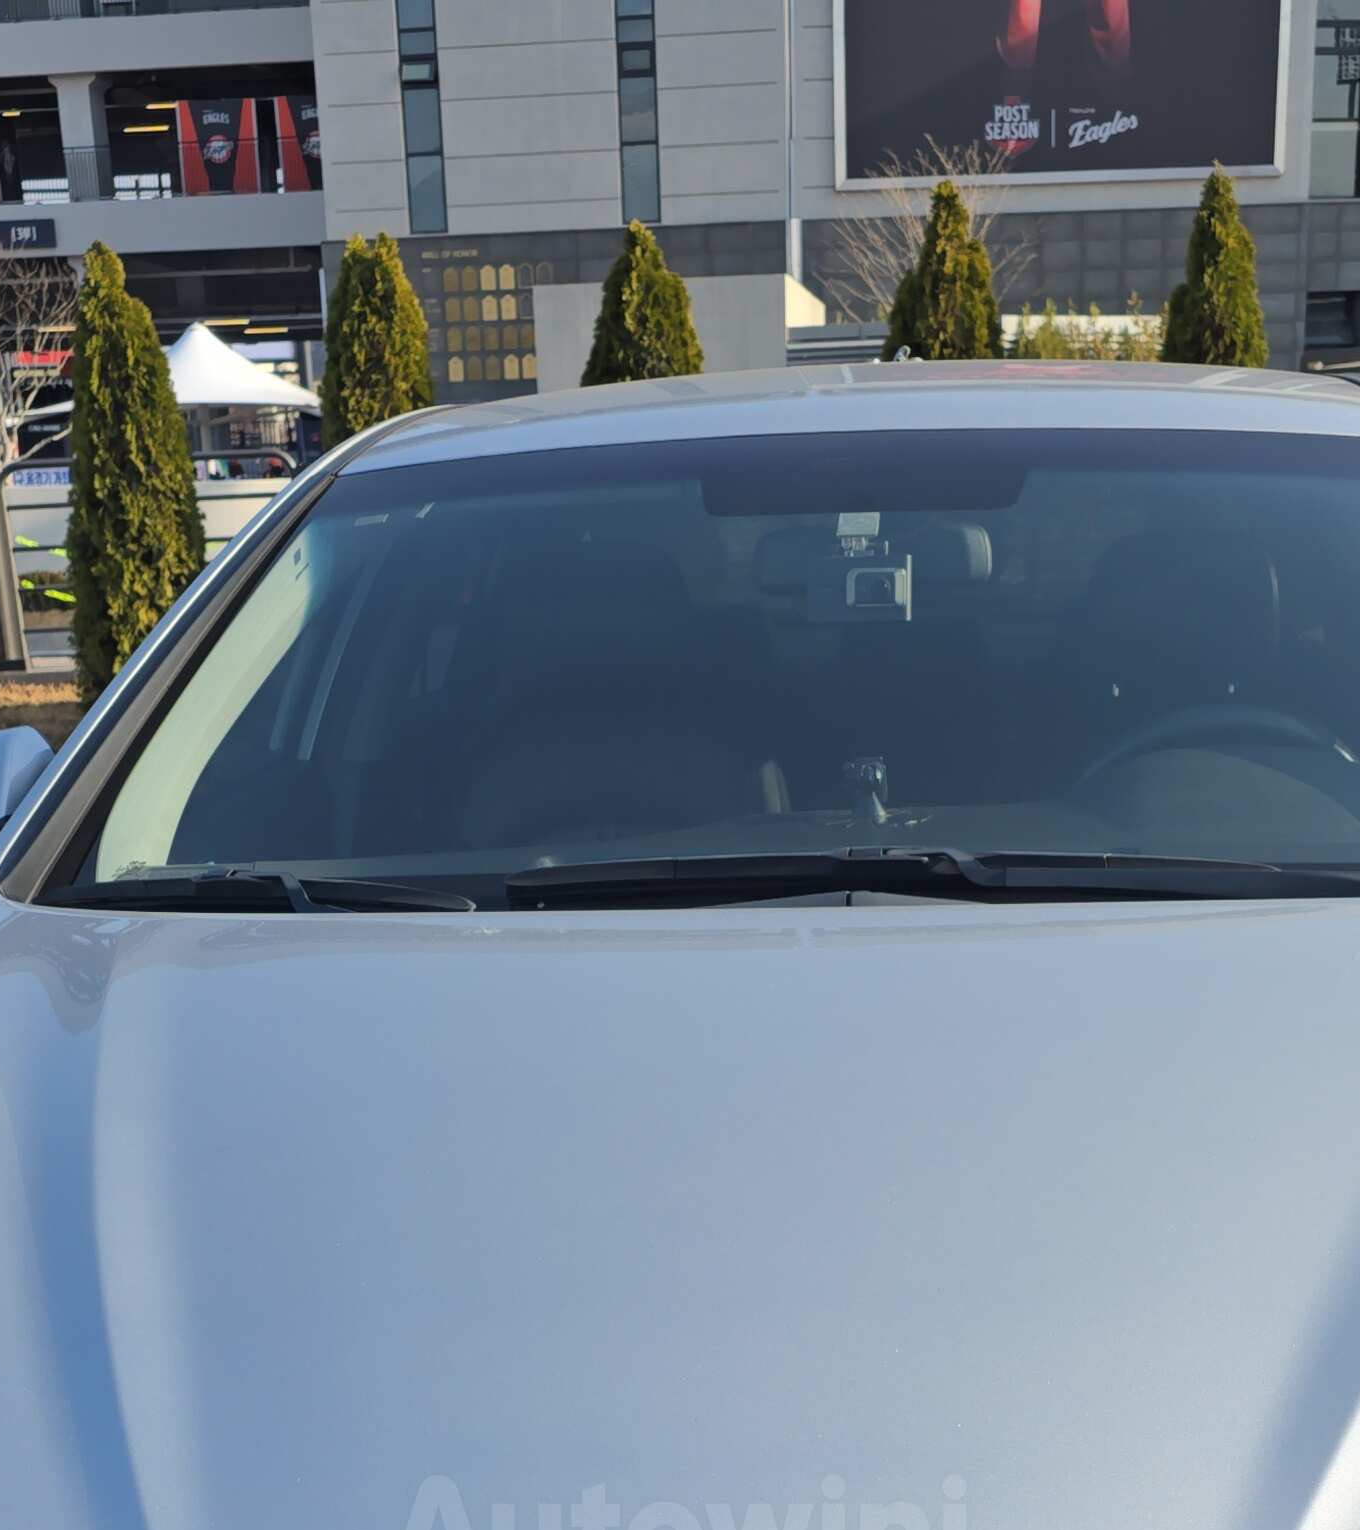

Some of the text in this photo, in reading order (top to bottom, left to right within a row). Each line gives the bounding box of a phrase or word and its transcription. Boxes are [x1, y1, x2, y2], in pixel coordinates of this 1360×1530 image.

[202, 112, 230, 125] EAGLES
[994, 104, 1030, 122] POST
[984, 121, 1040, 140] SEASON
[1068, 110, 1138, 148] Eagles
